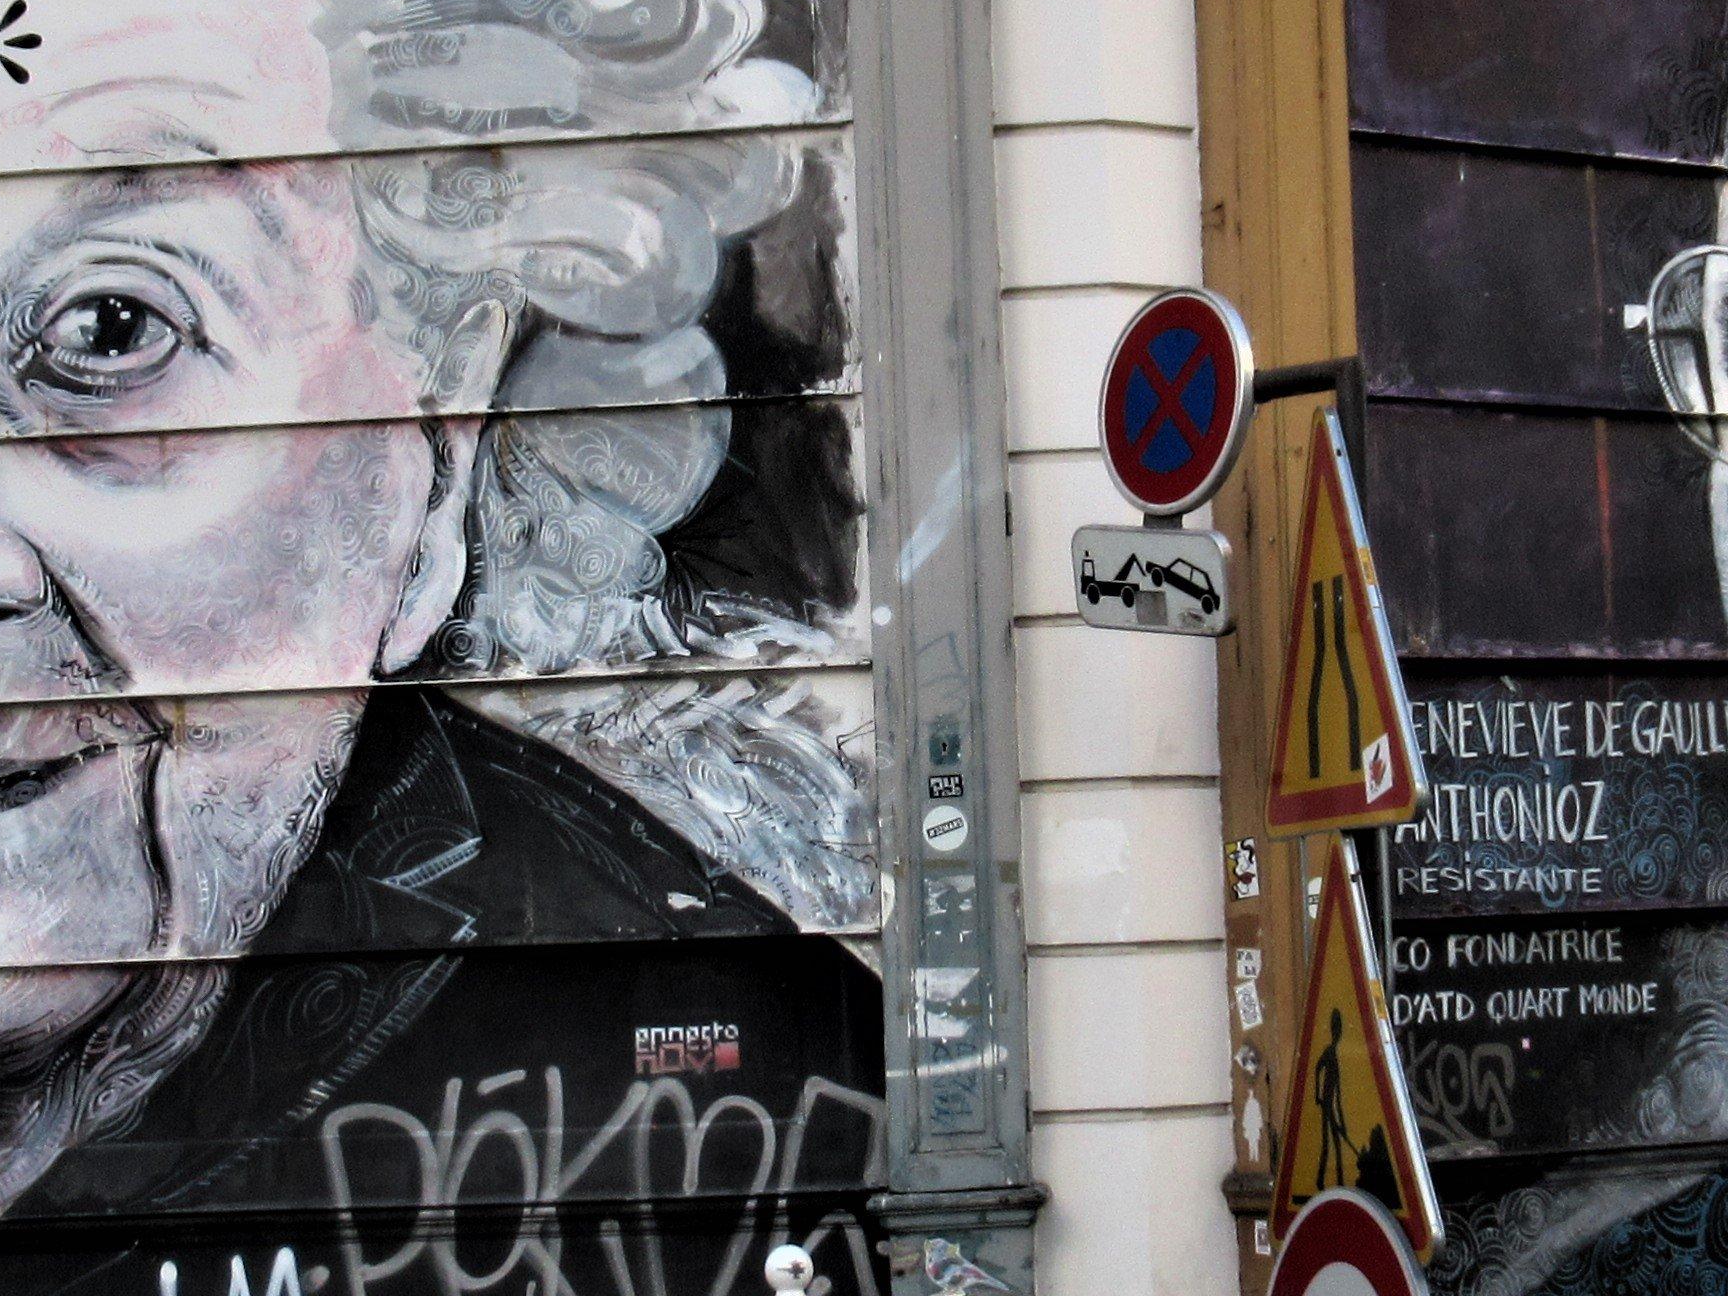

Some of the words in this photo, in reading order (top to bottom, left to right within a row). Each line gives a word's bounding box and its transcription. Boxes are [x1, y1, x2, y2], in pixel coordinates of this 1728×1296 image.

[1412, 675, 1576, 758] ENEVIÈVE
[1584, 700, 1625, 758] DE
[1396, 851, 1603, 897] RÉSISTANTE
[1392, 935, 1432, 973] CO
[1447, 924, 1624, 969] FONDATRICE
[1392, 988, 1476, 1028] D'ATD
[1486, 986, 1571, 1026] QUART
[1578, 981, 1660, 1017] MONDE
